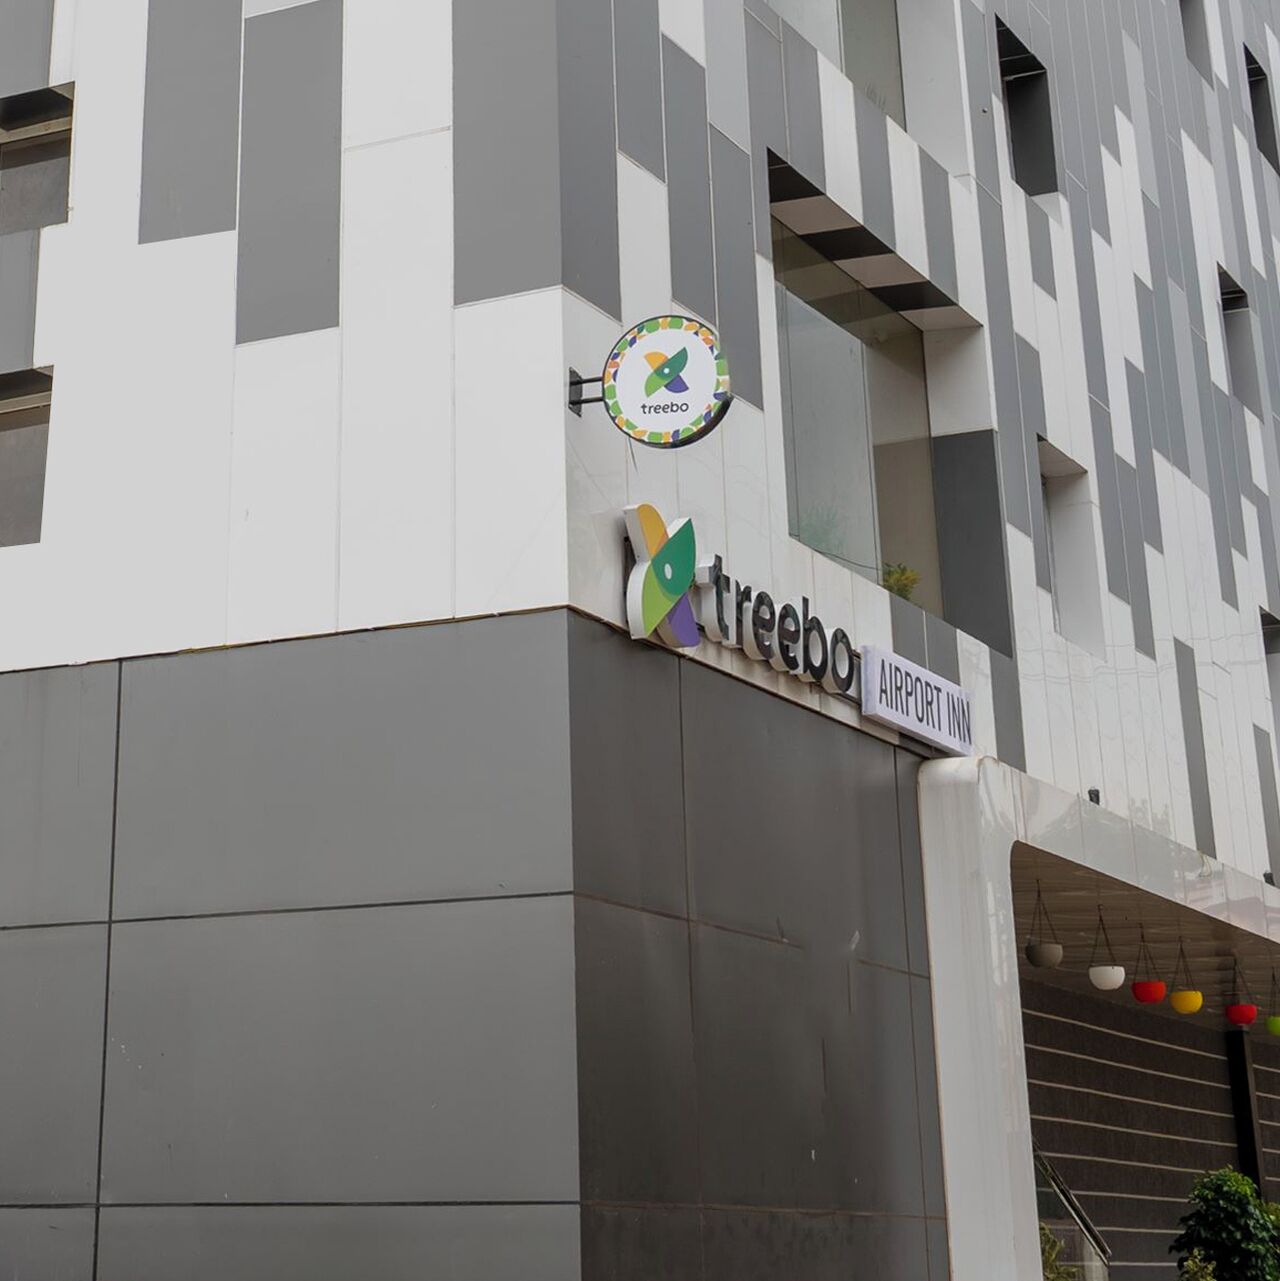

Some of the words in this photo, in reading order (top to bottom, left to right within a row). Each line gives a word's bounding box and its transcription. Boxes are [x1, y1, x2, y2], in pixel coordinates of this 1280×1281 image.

[641, 402, 689, 415] treebo
[704, 553, 855, 693] treebo
[879, 658, 942, 732] AIRPORT
[946, 691, 972, 746] INN
